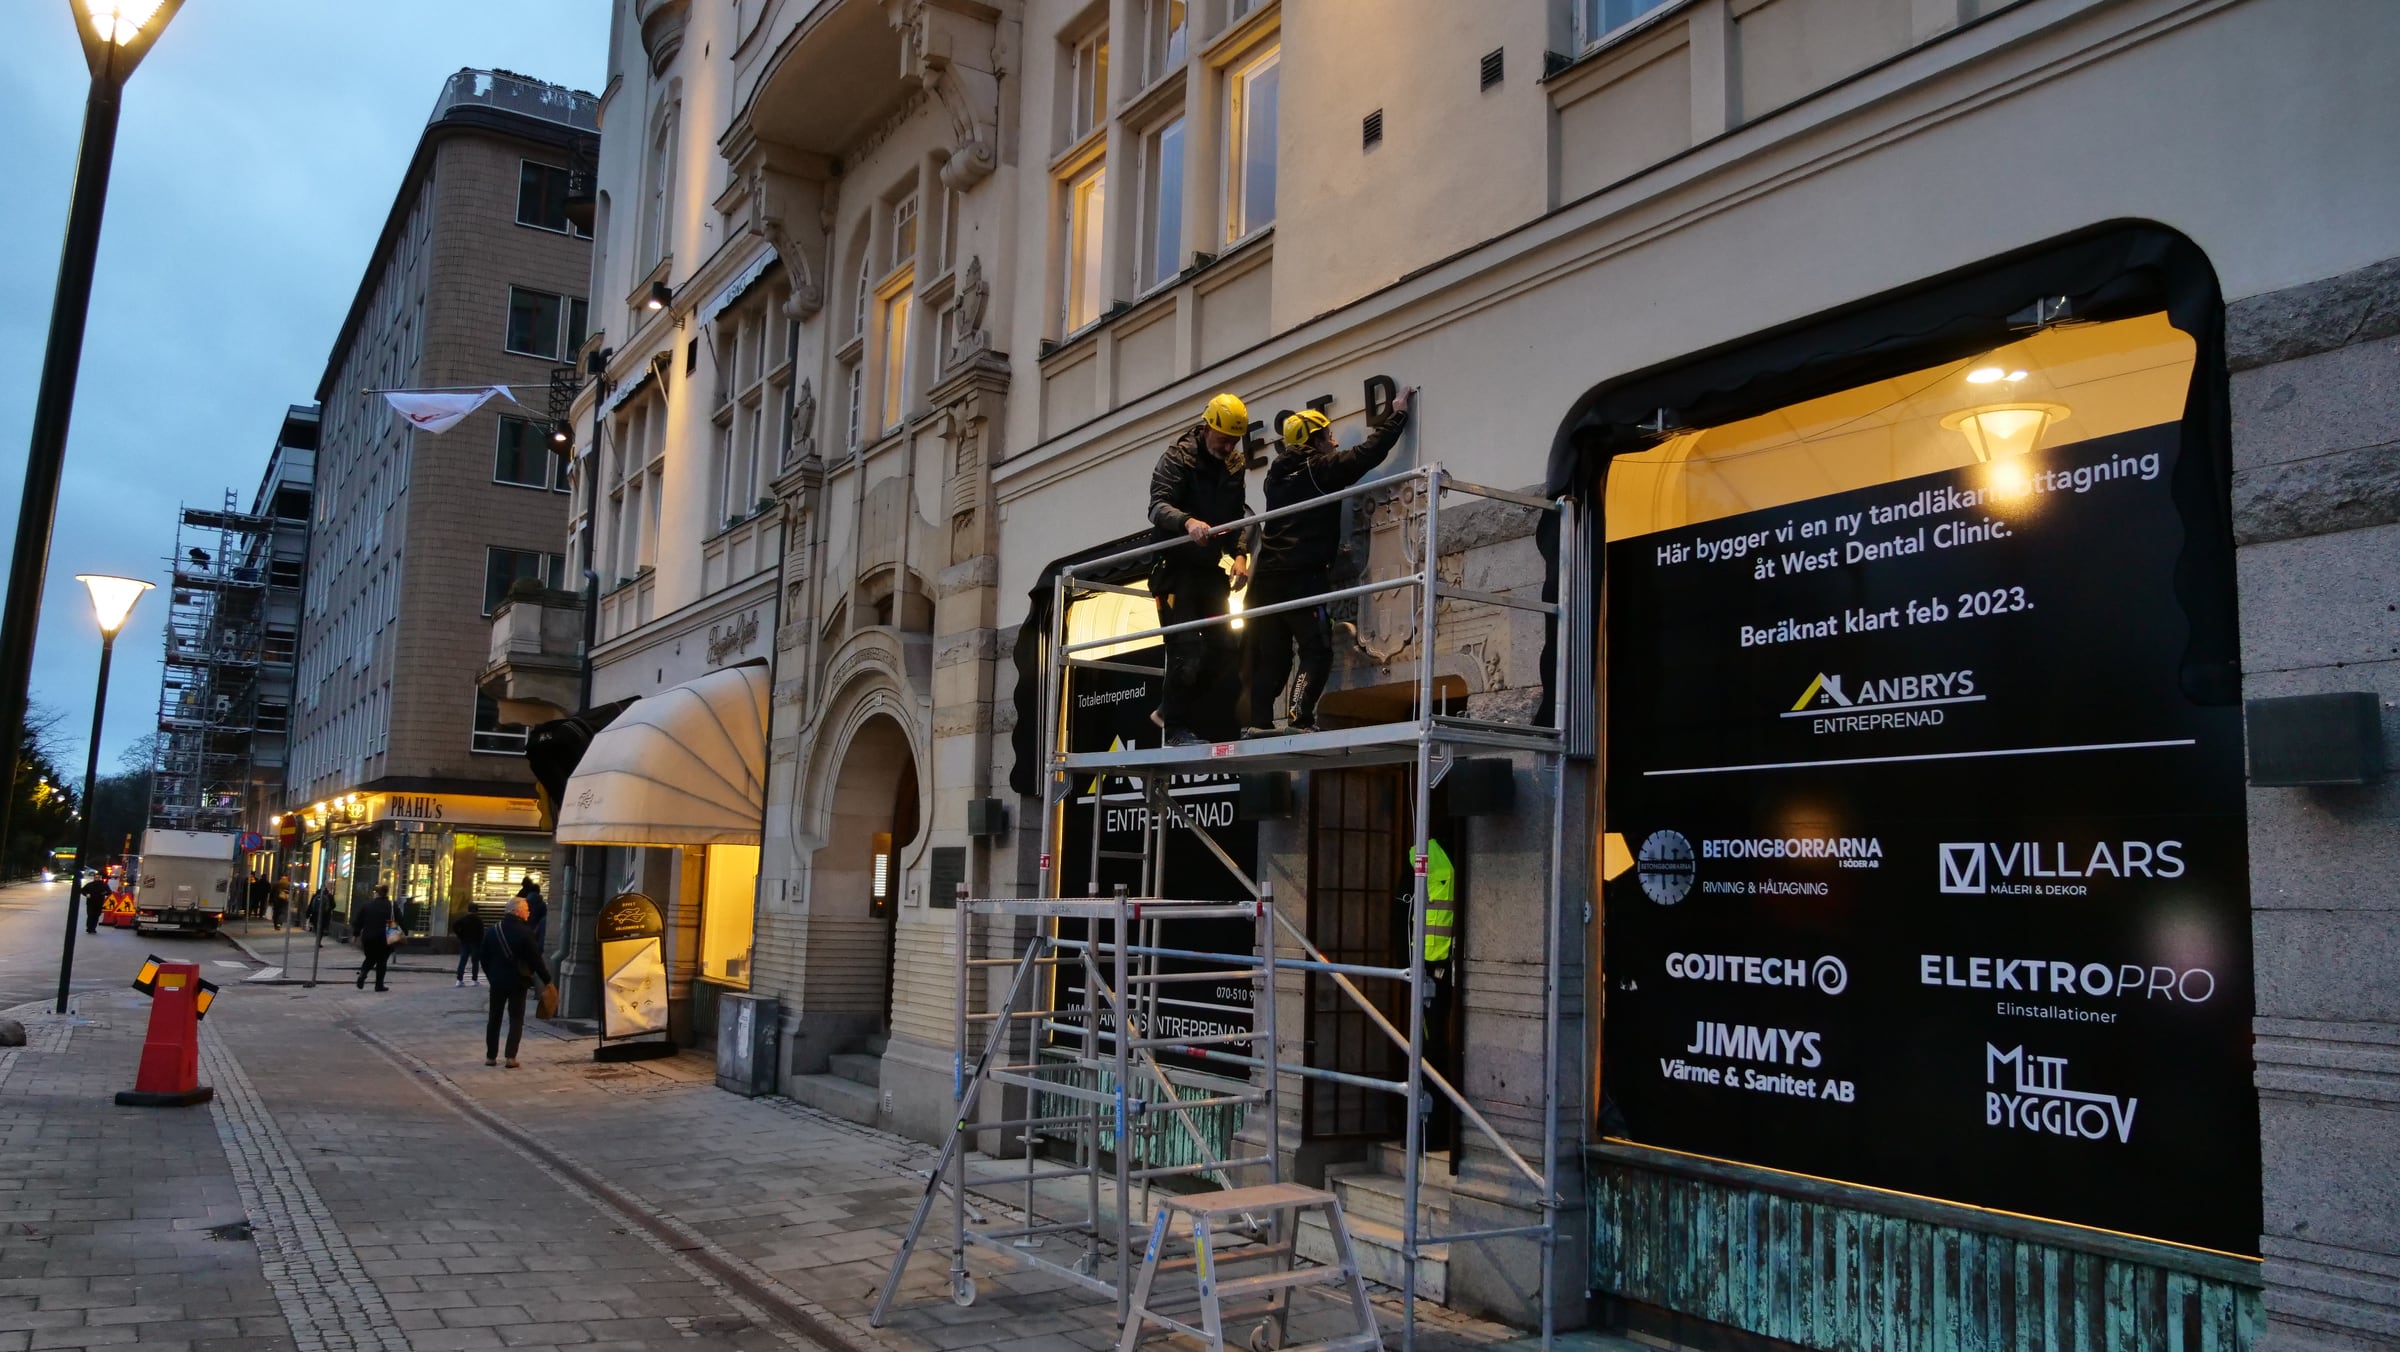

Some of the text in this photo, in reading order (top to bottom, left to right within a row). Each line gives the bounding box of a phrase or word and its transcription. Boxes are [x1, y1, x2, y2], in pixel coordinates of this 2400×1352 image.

[1364, 375, 1397, 427] D
[1657, 543, 1690, 566] Här
[1696, 531, 1769, 562] bygger
[1776, 520, 1793, 543] vi
[1800, 519, 1827, 538] en
[1835, 512, 1862, 536] ny
[1754, 518, 2012, 580] åt West Dental Clinic.
[1741, 586, 2034, 647] Beräknat klart feb 2023.
[1078, 681, 1146, 708] Totalentreprenad
[1857, 670, 1974, 704] ANBRYS
[1813, 709, 1944, 734] ENTREPRENAD
[1703, 838, 1883, 858] BETONGBORRARNA
[1843, 859, 1867, 868] SÖDER
[1990, 840, 2185, 878] VILLARS
[1703, 879, 1828, 895] RIVNING & HÅLTAGNING
[1991, 882, 2087, 895] MÅLERI & DEKOR
[1666, 952, 1806, 987] GOJITECH
[1921, 954, 2215, 1003] ELEKTROPRO
[1216, 986, 1247, 1001] 070-510
[1998, 1002, 2116, 1023] Elinstallationer
[1688, 1021, 1822, 1068] JIMMYS
[1660, 1058, 1855, 1103] Värme & Sanitet AB
